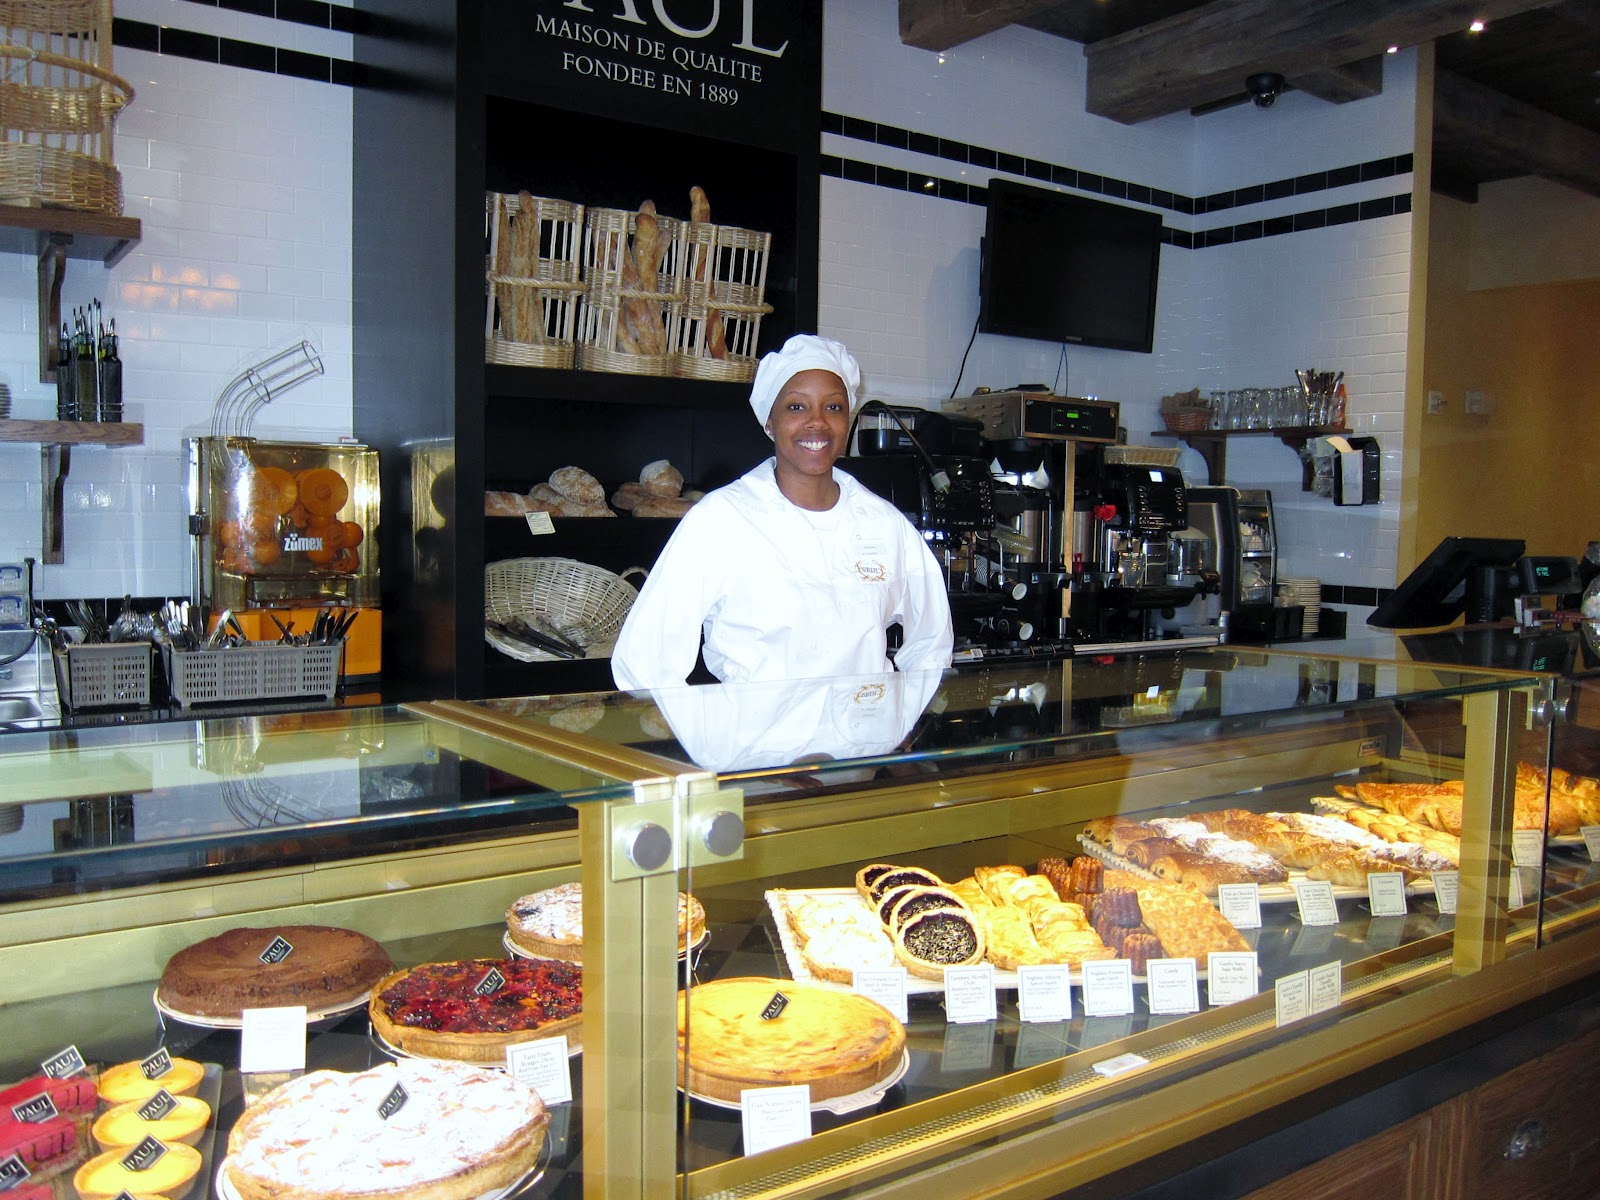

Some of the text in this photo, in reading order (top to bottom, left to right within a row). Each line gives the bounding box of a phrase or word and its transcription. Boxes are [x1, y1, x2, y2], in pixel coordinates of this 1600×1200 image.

[563, 0, 789, 58] UL
[535, 14, 762, 82] MAISON DE QUALITE
[563, 52, 738, 106] FONDEE EN 1889
[264, 942, 286, 962] PAUL
[479, 974, 499, 994] PAUL
[763, 997, 784, 1020] PAUL
[48, 1054, 79, 1077] PAUL
[143, 1055, 169, 1075] PAUL
[18, 1099, 50, 1120] PAUL
[141, 1093, 170, 1120] PAUL
[380, 1089, 403, 1117] PAUL
[126, 1140, 157, 1170] PAUL
